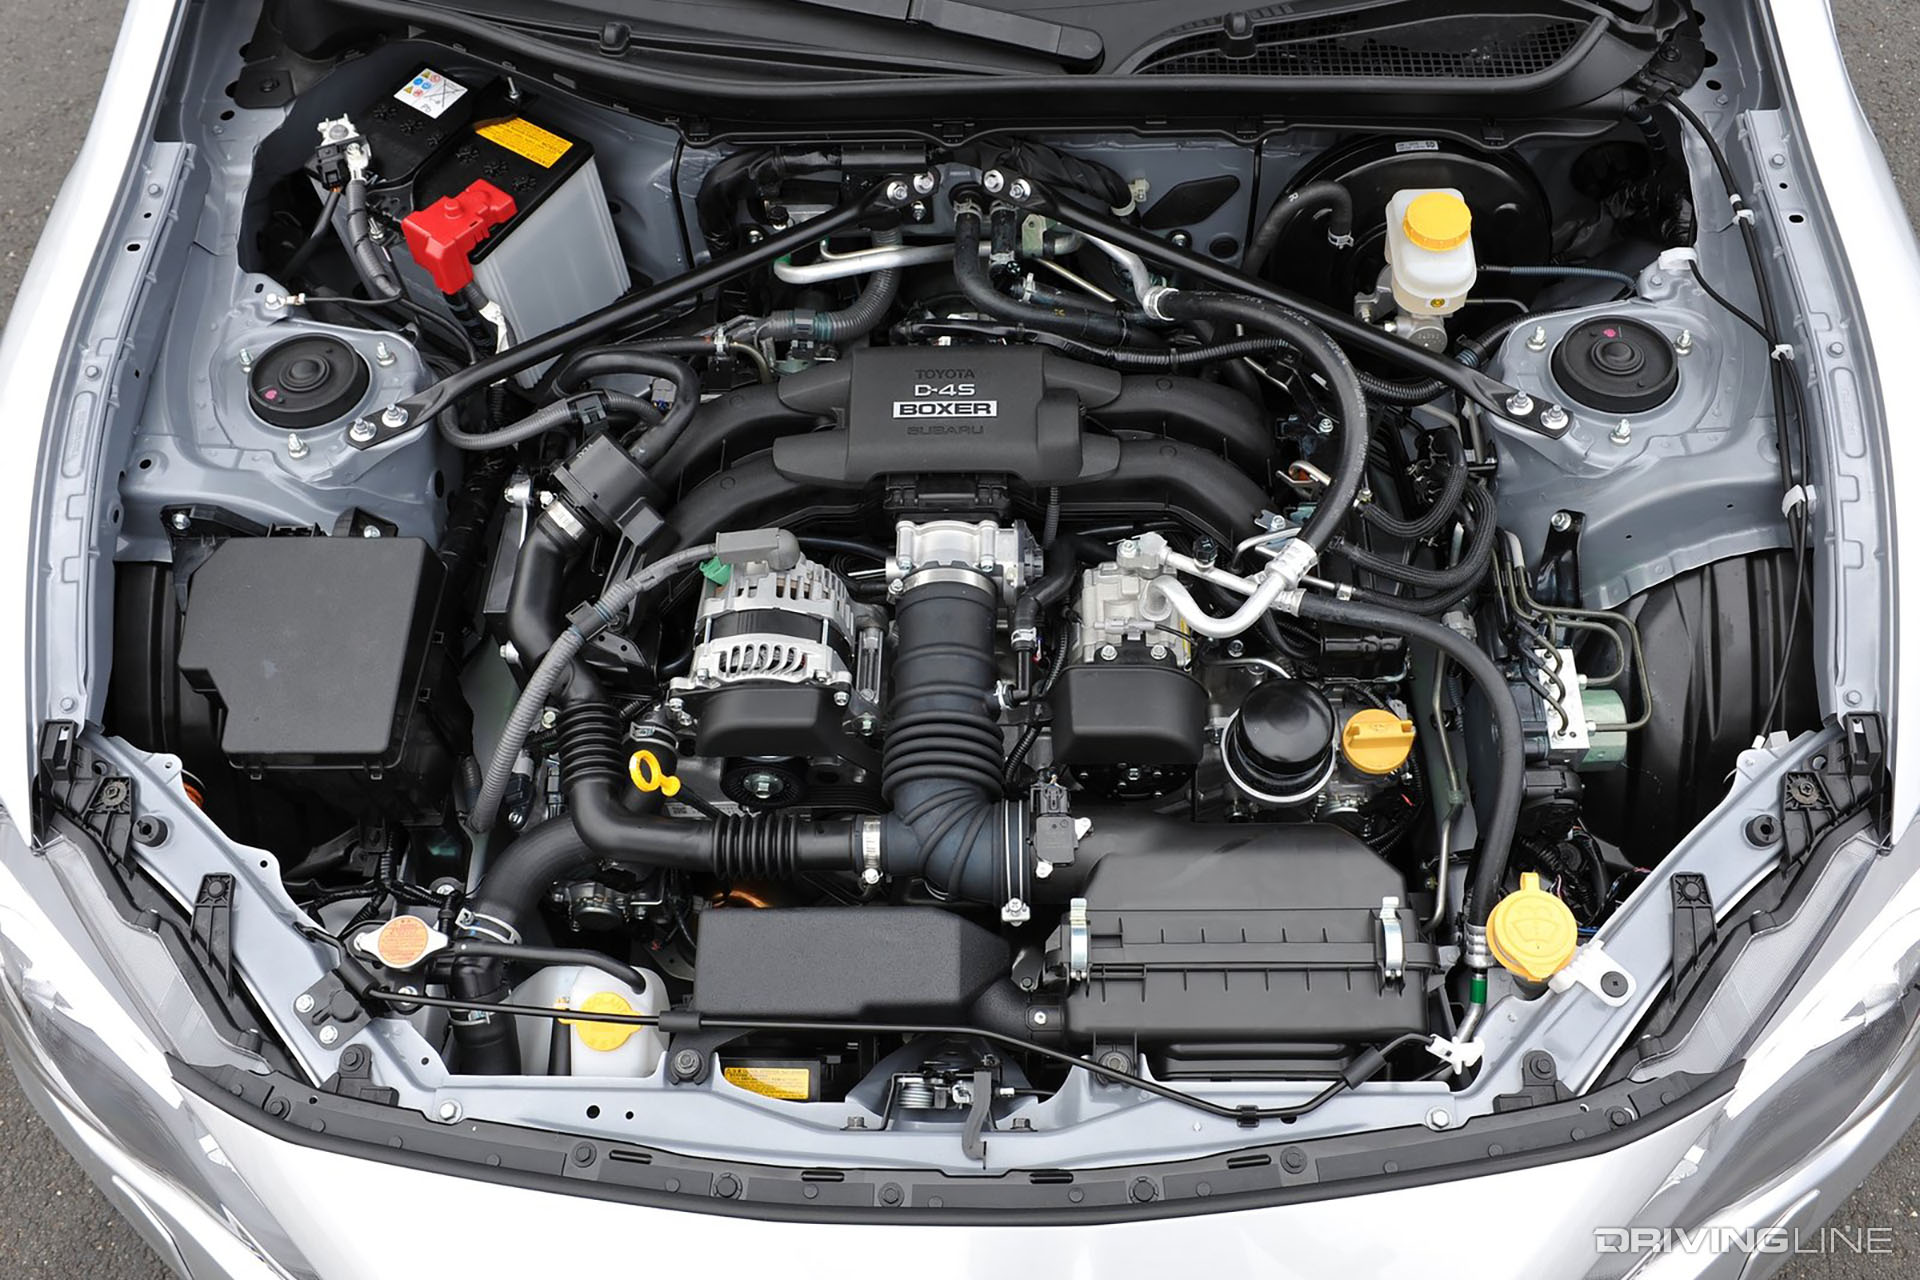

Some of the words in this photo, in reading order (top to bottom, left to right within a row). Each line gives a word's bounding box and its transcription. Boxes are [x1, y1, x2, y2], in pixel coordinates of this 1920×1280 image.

[914, 369, 976, 379] TOYOTA
[914, 384, 976, 396] D-4S
[899, 403, 992, 416] BOXER
[907, 425, 984, 436] SUBARU
